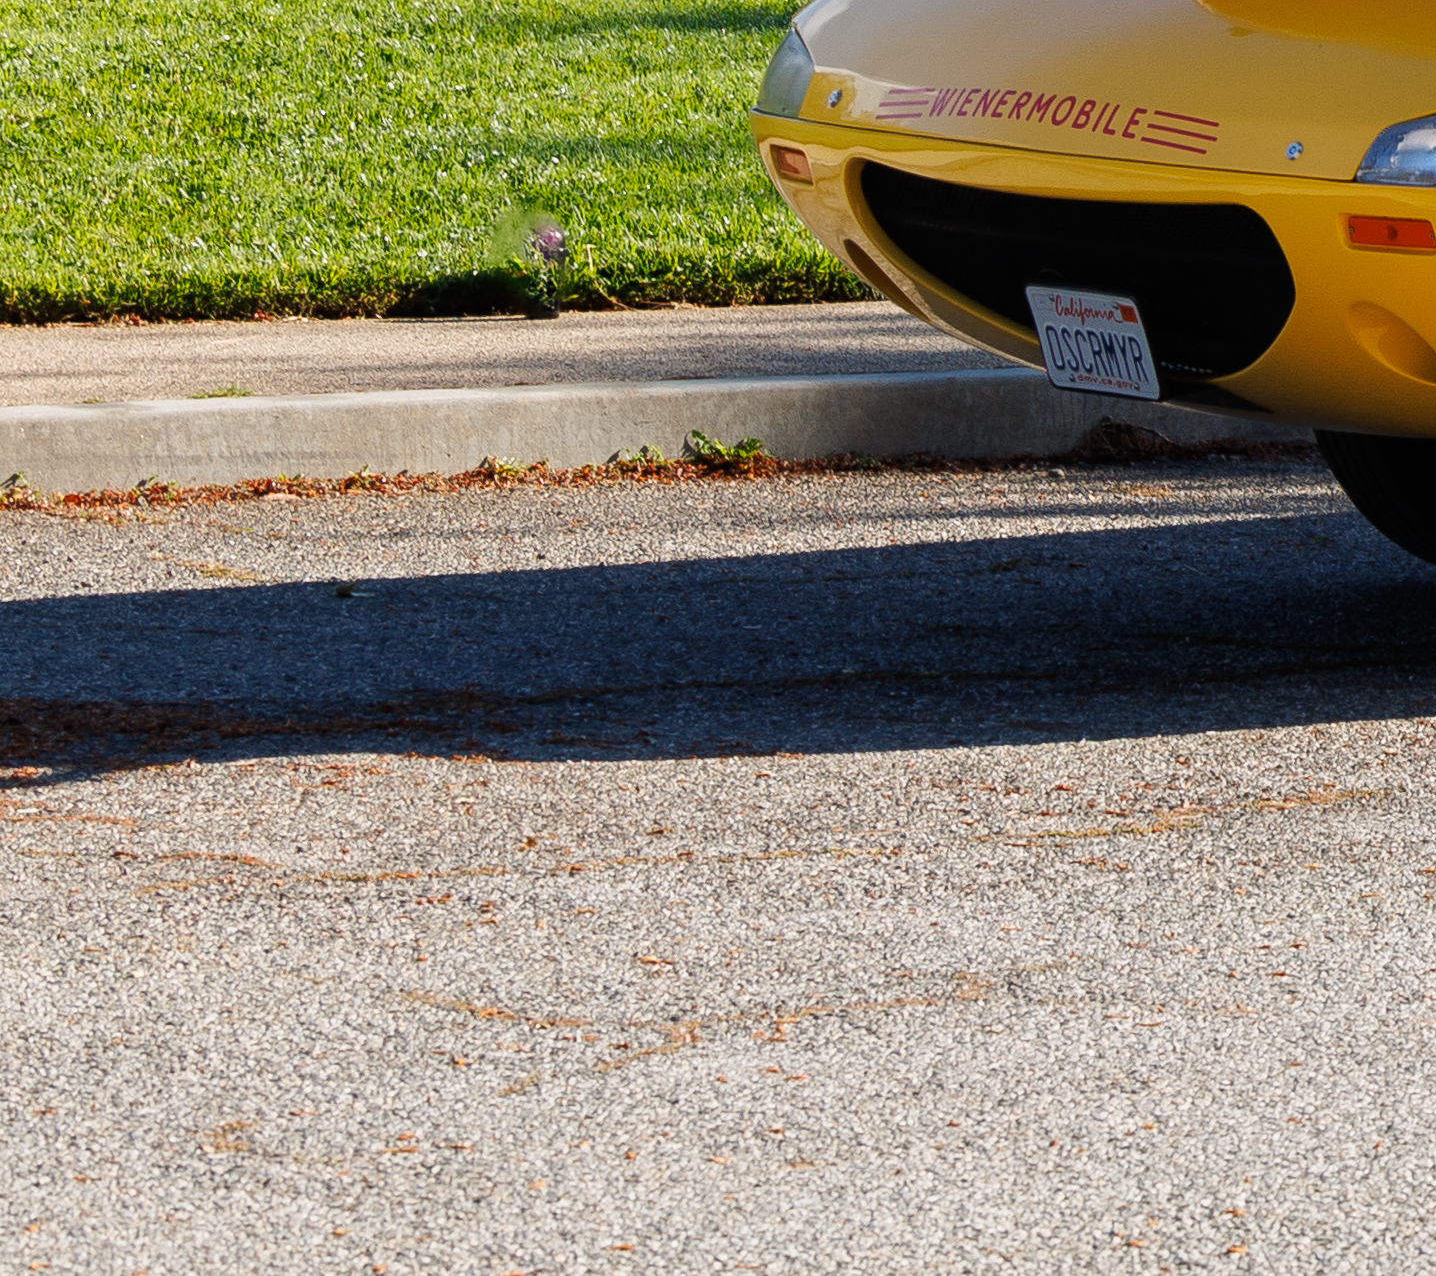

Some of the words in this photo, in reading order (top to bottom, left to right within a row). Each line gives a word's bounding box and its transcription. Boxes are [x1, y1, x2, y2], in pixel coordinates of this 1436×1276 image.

[929, 87, 1148, 139] WIENERMOBILE
[1054, 294, 1125, 326] California
[1045, 325, 1149, 383] OSCRMYR
[1077, 374, 1133, 389] dmv.ca.gov
